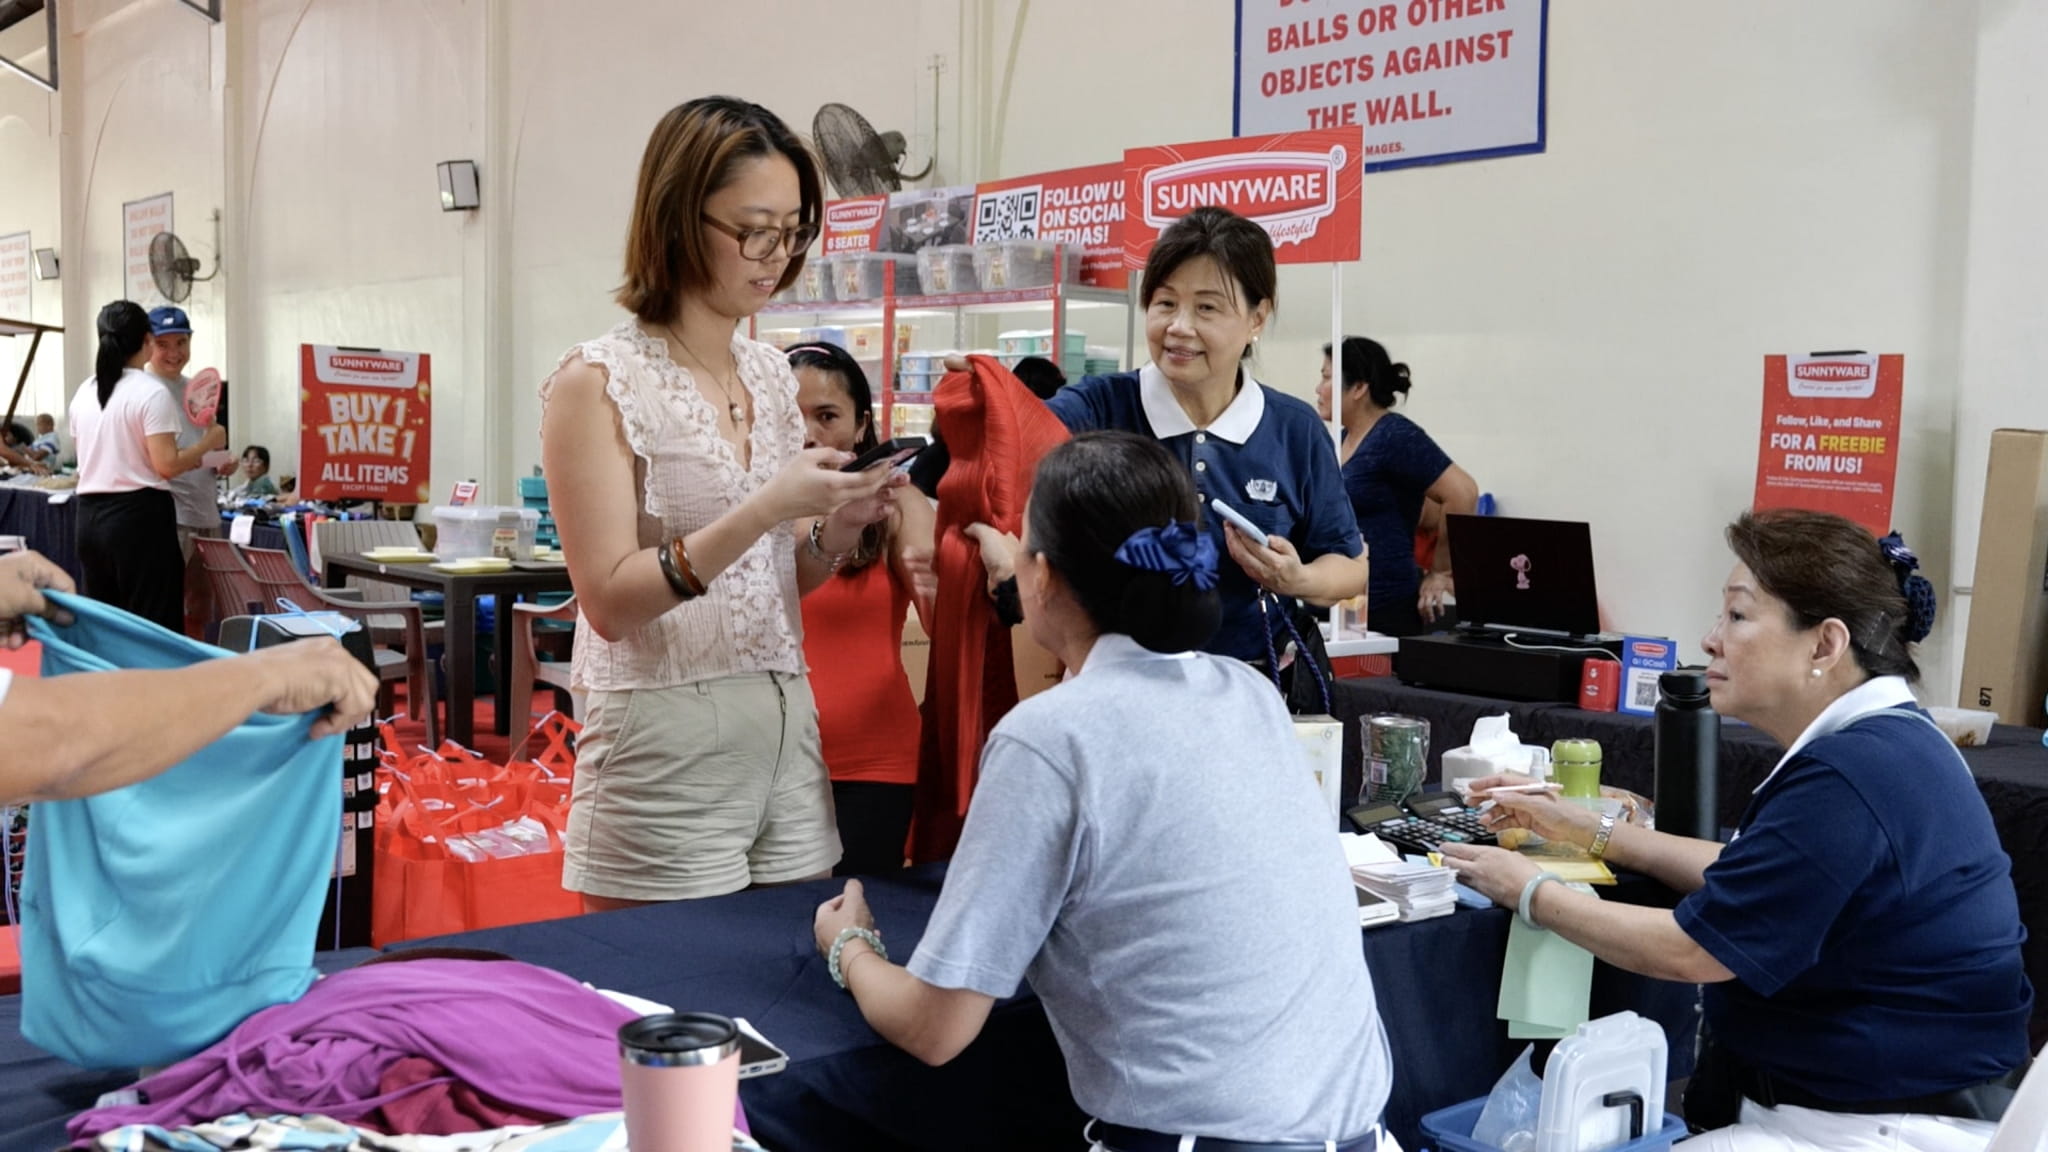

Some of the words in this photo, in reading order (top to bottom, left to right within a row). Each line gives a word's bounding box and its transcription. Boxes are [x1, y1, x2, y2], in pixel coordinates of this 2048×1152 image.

[1267, 14, 1349, 53] BALLS
[1357, 5, 1398, 36] OR
[1260, 54, 1375, 98] OBJECTS
[1382, 29, 1514, 78] AGAINST
[1307, 102, 1357, 130] THE
[1366, 90, 1453, 126] WALL.
[1043, 182, 1111, 208] FOLLOW
[1157, 173, 1322, 211] SUNNYWARE
[1042, 208, 1066, 229] ON
[835, 234, 871, 249] SEATER
[1041, 224, 1109, 246] MEDIAS!
[332, 356, 402, 371] SUNNYWARE
[1797, 366, 1868, 377] SUNNYWARE
[328, 393, 391, 424] BUY
[392, 397, 408, 428] 1
[1853, 417, 1883, 429] Share
[318, 423, 398, 456] TAKE
[400, 429, 416, 460] 1
[1770, 432, 1802, 450] FOR
[1804, 434, 1817, 451] A
[1819, 434, 1886, 454] FREEBIE
[321, 462, 354, 482] ALL
[357, 463, 409, 485] ITEMS
[1784, 453, 1831, 471] FROM
[1834, 456, 1864, 474] US!
[1979, 687, 1993, 707] 871
